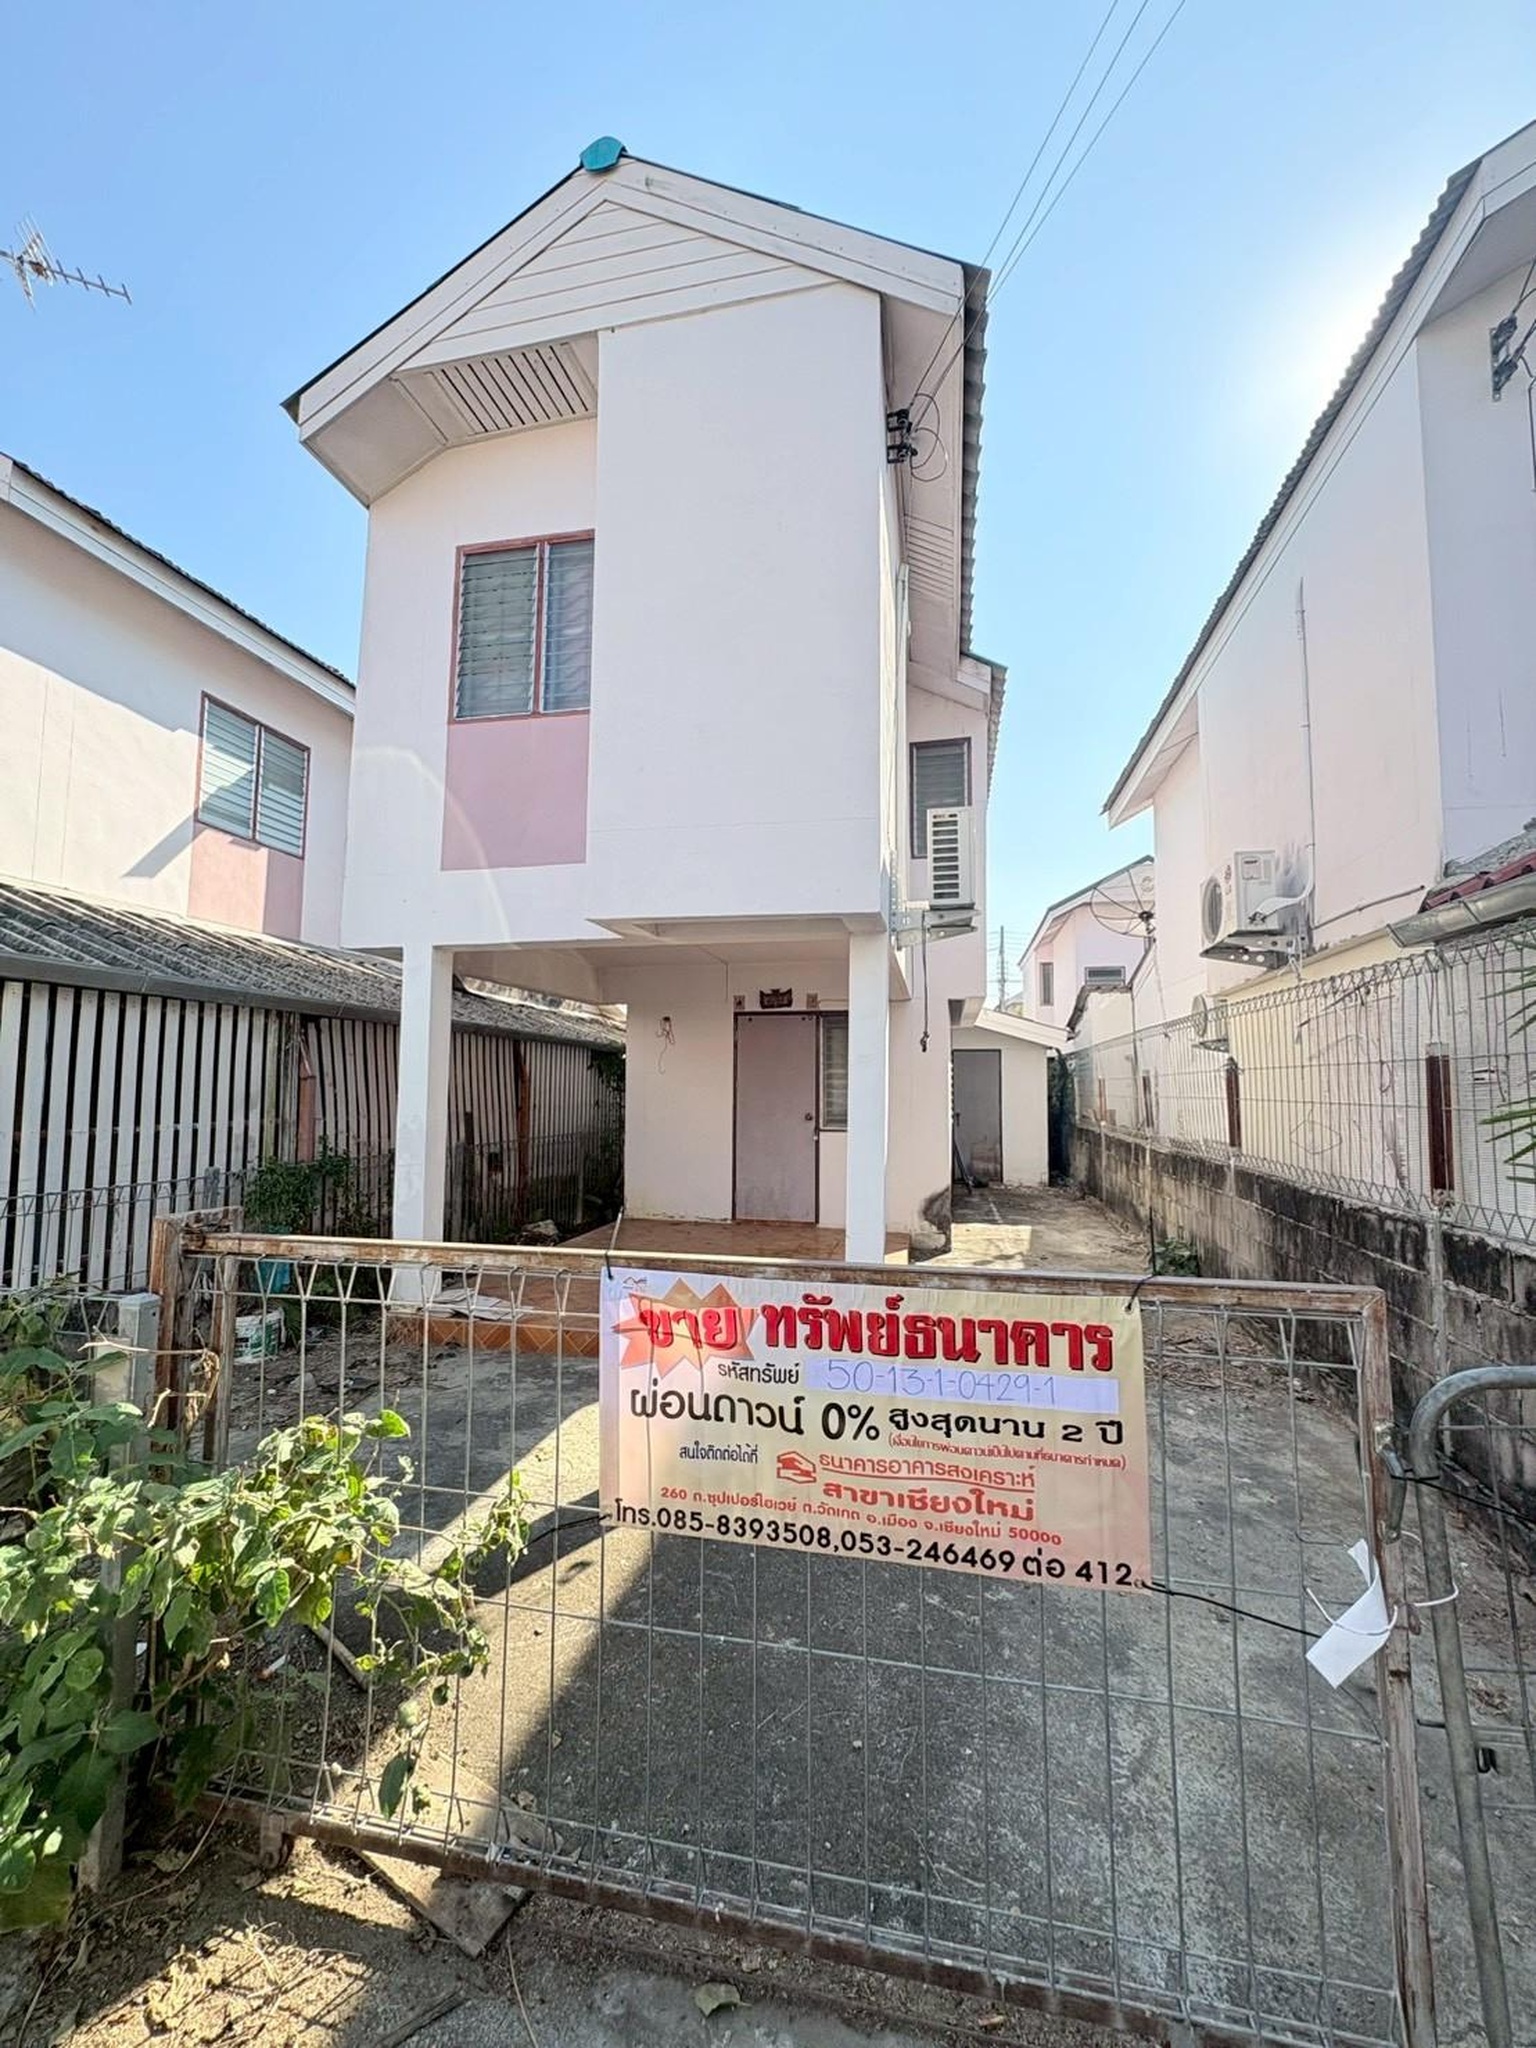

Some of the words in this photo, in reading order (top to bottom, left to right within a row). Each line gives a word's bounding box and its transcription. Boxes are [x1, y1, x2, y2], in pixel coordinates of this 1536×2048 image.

[639, 1306, 738, 1350] ขาย
[760, 1292, 1114, 1371] ทรัพย์ธนาคาร
[718, 1361, 800, 1385] รหัสทรัพย์
[630, 1377, 805, 1436] ผ่อนดาวน์
[821, 1401, 880, 1441] 0%
[888, 1406, 1046, 1438] สูงสุดนาน
[1061, 1424, 1083, 1443] 2
[1095, 1419, 1123, 1446] ปี
[679, 1440, 758, 1464] สนใจติดต่อได้ที่
[819, 1453, 1035, 1487] ธนาคารอาคารสงเคราะห์
[660, 1486, 688, 1500] 260
[866, 1513, 918, 1529] อ.เมือง
[924, 1519, 1002, 1539] จ.เชียงใหม่
[1008, 1526, 1062, 1546] 50000
[822, 1481, 1034, 1522] สาขาเชียงใหม่
[1022, 1547, 1066, 1579] ต่อ
[1075, 1560, 1133, 1587] 412
